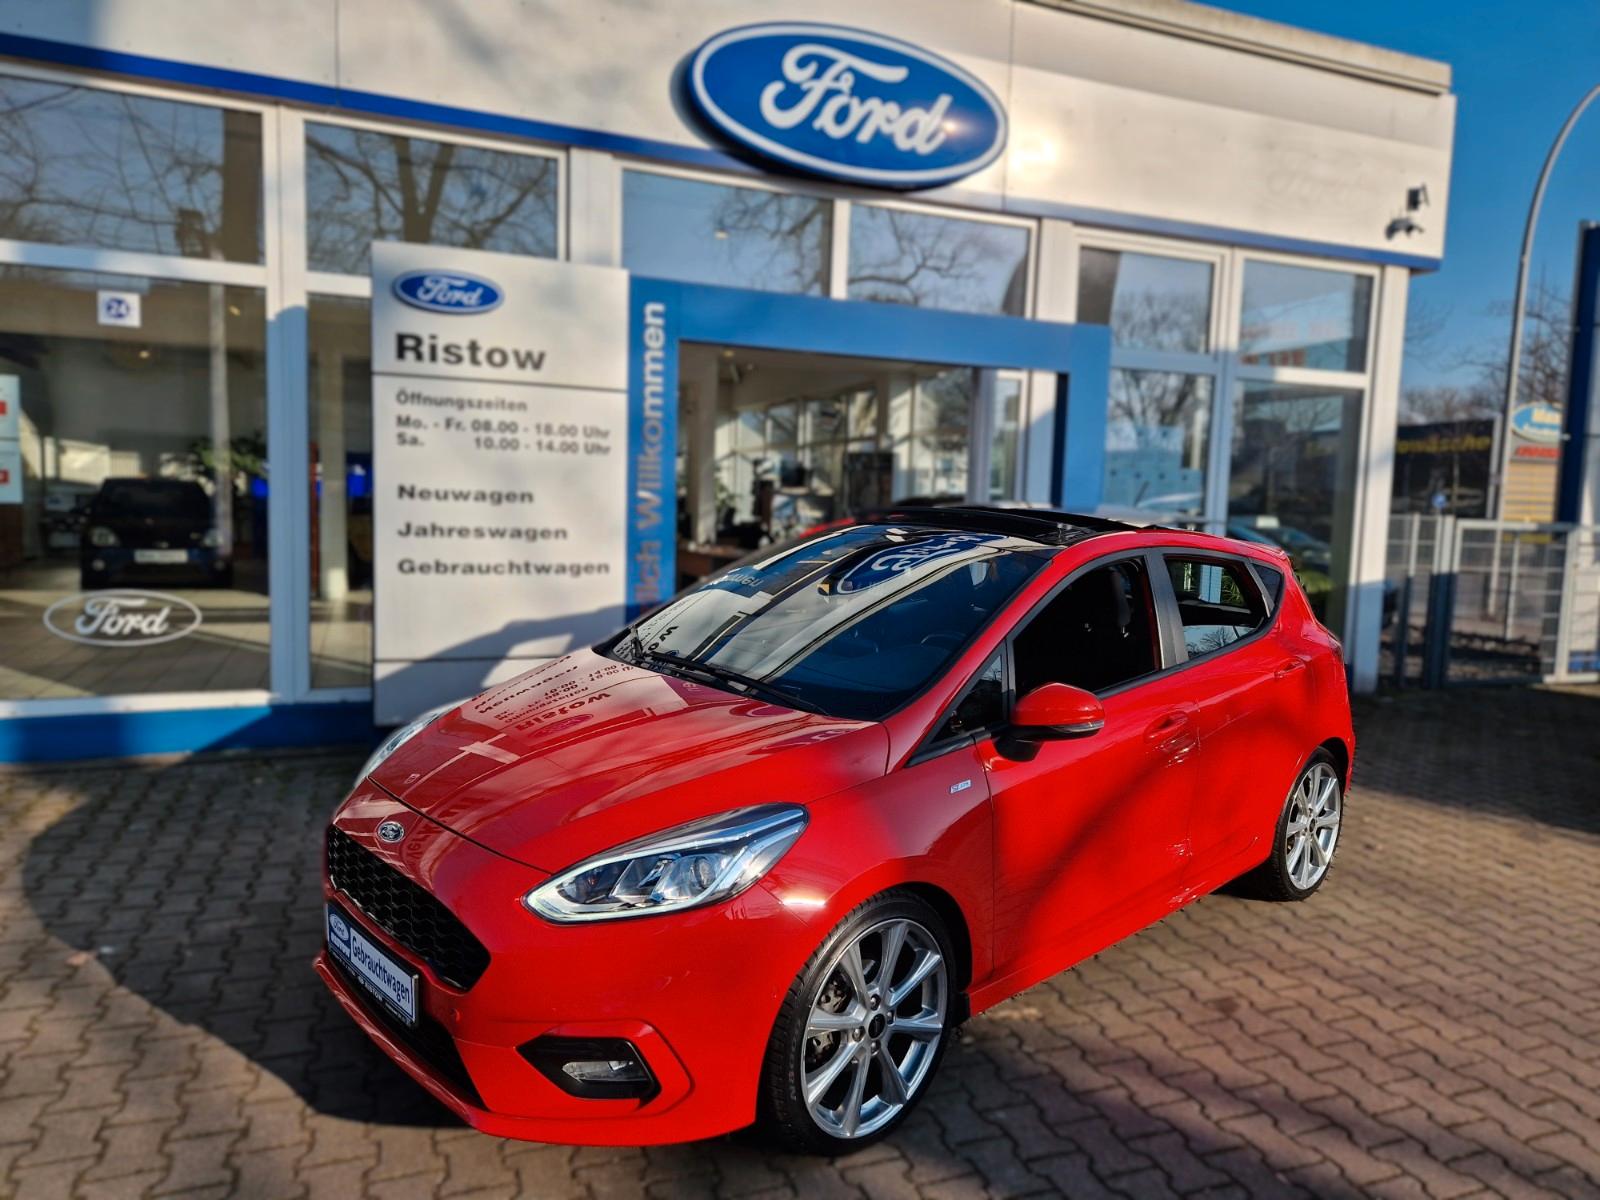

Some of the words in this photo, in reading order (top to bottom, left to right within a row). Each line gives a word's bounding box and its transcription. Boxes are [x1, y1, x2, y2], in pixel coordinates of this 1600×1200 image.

[760, 44, 953, 155] Ford
[416, 275, 484, 306] Ford
[395, 332, 546, 371] Ristow
[396, 390, 528, 412] Öffnungszeiten
[396, 415, 429, 430] Mo.
[445, 417, 467, 432] Fr.
[471, 418, 519, 434] 08.00
[535, 423, 578, 438] 18.00
[583, 425, 610, 439] Uhr
[636, 301, 665, 529] Willkommen
[397, 432, 424, 447] Sa.
[475, 437, 520, 451] 10.00
[537, 440, 579, 454] 14.00
[584, 442, 611, 455] Uhr
[397, 485, 535, 504] Neuwagen
[397, 522, 568, 542] Jahreswagen
[397, 558, 610, 577] Gebrauchtwagen
[75, 597, 170, 635] Ford
[352, 935, 410, 1004] Gebrauchtwagen
